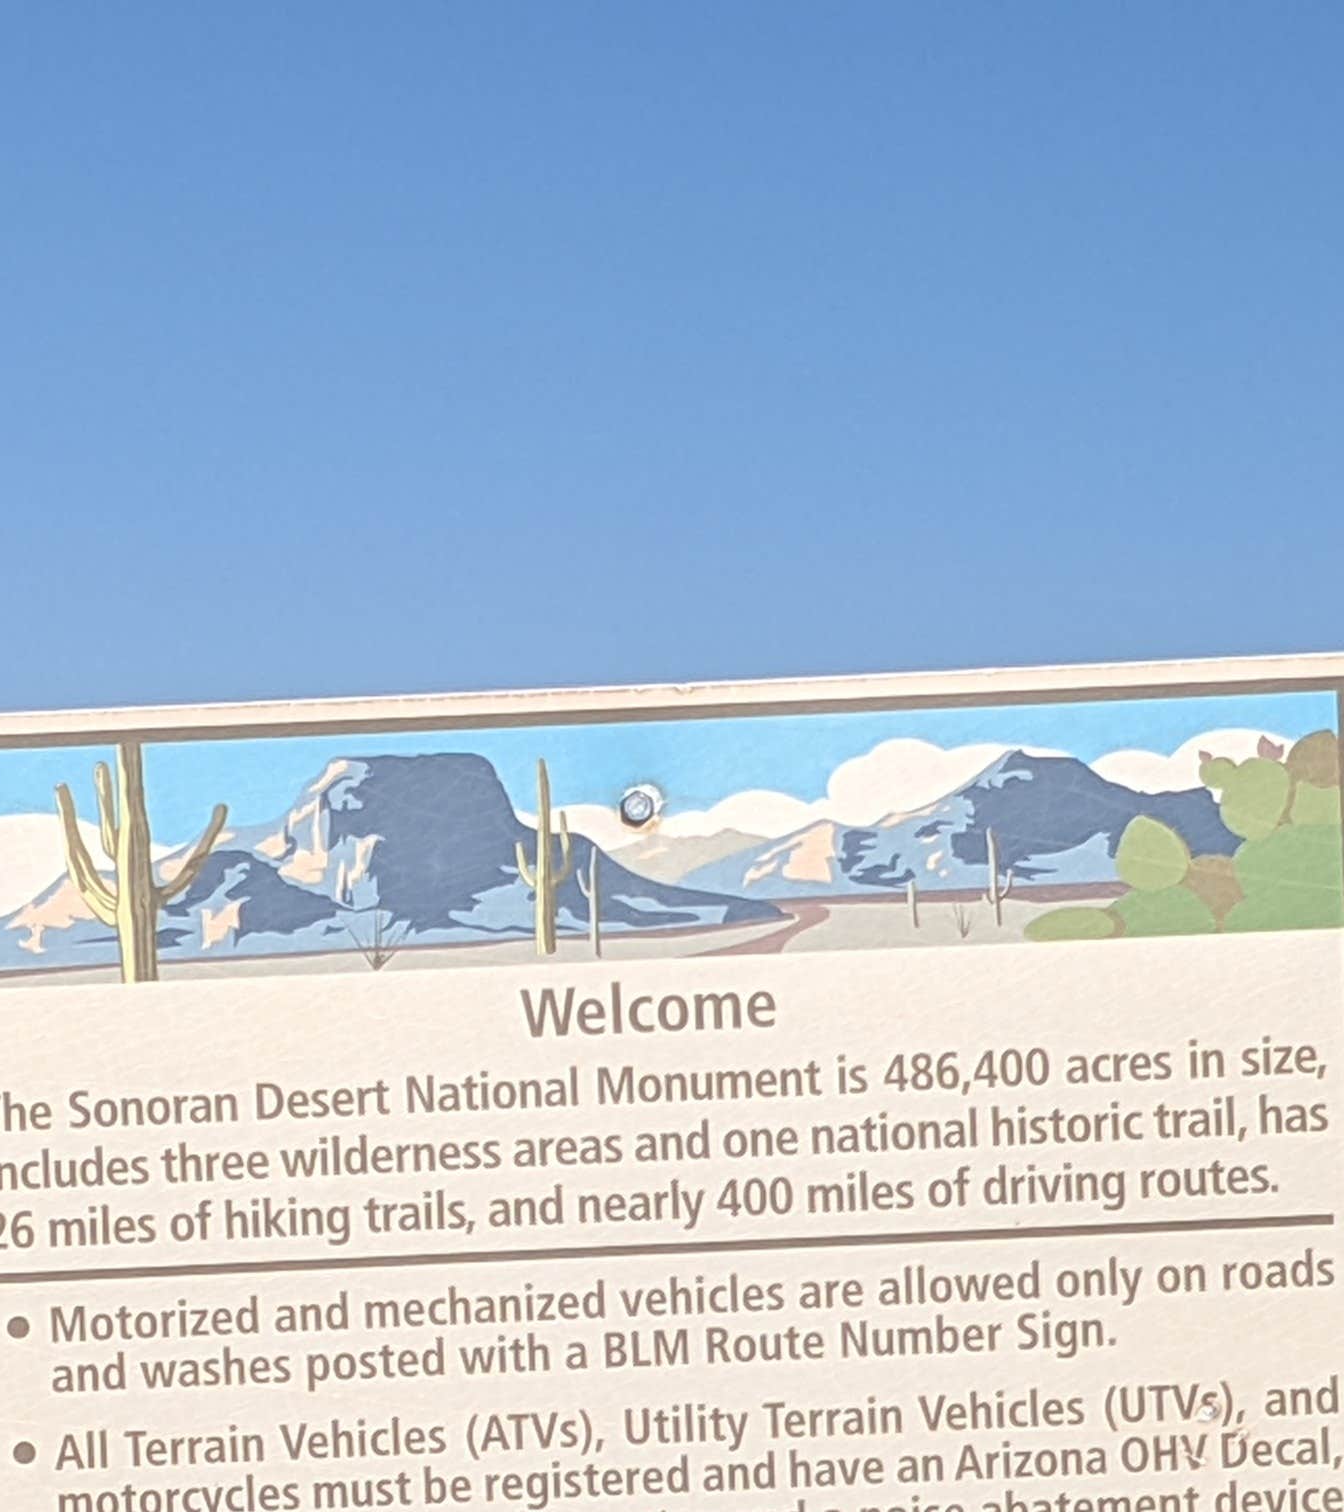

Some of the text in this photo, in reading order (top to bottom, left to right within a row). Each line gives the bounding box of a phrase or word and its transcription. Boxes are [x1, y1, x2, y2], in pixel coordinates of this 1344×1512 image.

[519, 981, 776, 1038] Welcome
[68, 1090, 239, 1129] Sonoran
[255, 1079, 391, 1120] Desert
[406, 1065, 579, 1114] National
[597, 1060, 823, 1105] Monument
[836, 1054, 868, 1095] is
[883, 1047, 1050, 1096] 486,400
[1066, 1051, 1173, 1084] acres
[1188, 1039, 1225, 1079] in
[1241, 1035, 1327, 1080] size,
[159, 1141, 270, 1184] three
[279, 1133, 502, 1178] wilderness
[513, 1134, 623, 1168] areas
[634, 1118, 711, 1162] and
[723, 1126, 799, 1158] one
[811, 1106, 979, 1155] national
[991, 1101, 1144, 1147] historic
[1152, 1095, 1248, 1143] trail,
[1258, 1093, 1329, 1135] has
[48, 1203, 157, 1248] miles
[170, 1199, 213, 1242] of
[224, 1196, 351, 1246] hiking
[362, 1189, 476, 1235] trails,
[488, 1183, 564, 1228] and
[578, 1178, 706, 1231] nearly
[716, 1176, 794, 1218] 400
[807, 1170, 915, 1214] miles
[928, 1165, 971, 1208] of
[983, 1162, 1126, 1212] driving
[1140, 1159, 1279, 1199] routes.
[50, 1247, 1335, 1344] Motorized and mechanized vehicles are allowed only on roads
[52, 1309, 1117, 1393] and washes posted with a BLM Route Number Sign.
[55, 1429, 108, 1471] All
[123, 1424, 265, 1467] Terrain
[279, 1416, 447, 1461] Vehicles
[466, 1409, 605, 1461] (ATVs),
[624, 1403, 749, 1452] Utility
[761, 1395, 903, 1439] Terrain
[917, 1387, 1085, 1432] Vehicles
[1264, 1374, 1339, 1417] and
[313, 1471, 413, 1510] must
[423, 1465, 472, 1505] be
[485, 1453, 690, 1511] registered
[703, 1450, 776, 1492] and
[789, 1448, 884, 1489] have
[897, 1454, 944, 1484] an
[954, 1440, 1108, 1481] Arizona
[1121, 1433, 1209, 1473] OHV
[1220, 1425, 1343, 1470] Decal,
